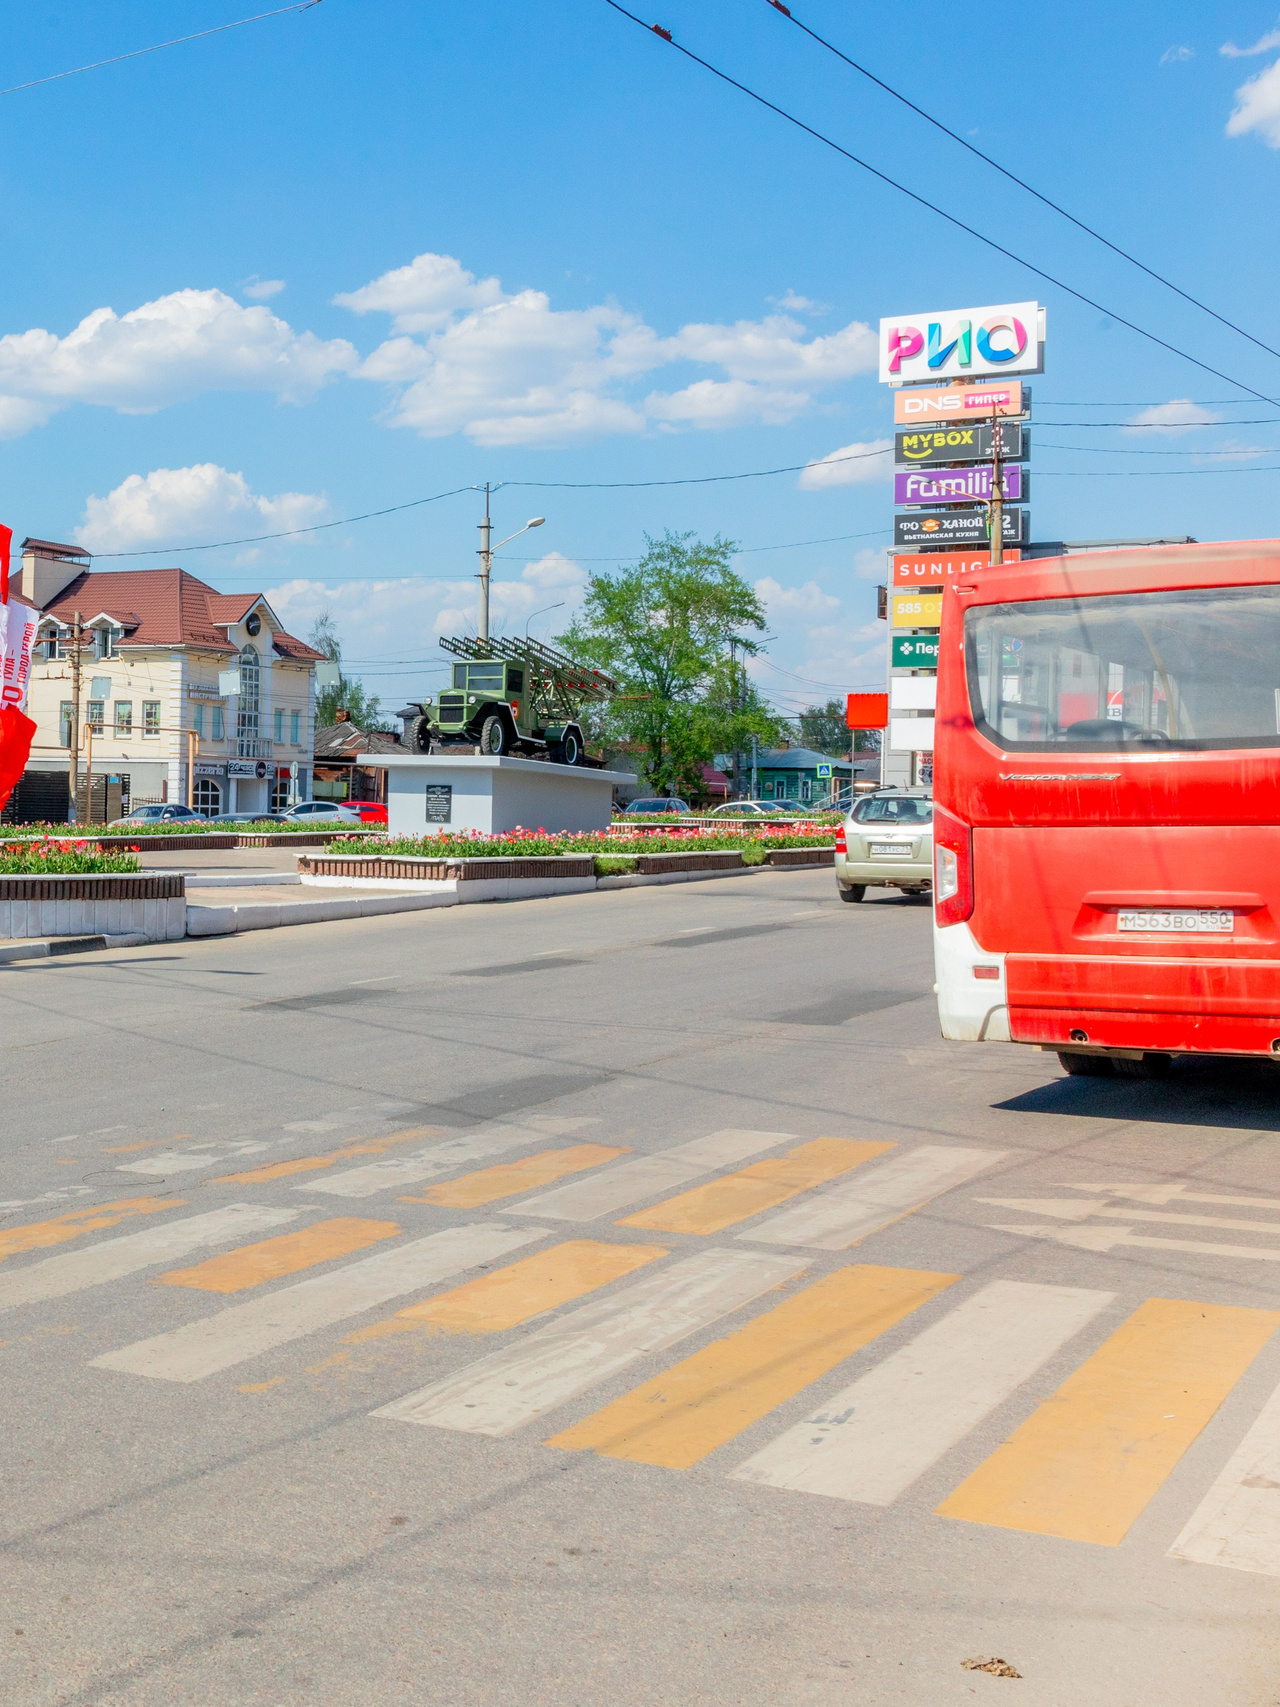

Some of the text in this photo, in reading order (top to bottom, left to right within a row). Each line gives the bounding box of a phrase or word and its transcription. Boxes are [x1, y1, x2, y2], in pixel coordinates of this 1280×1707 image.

[888, 315, 1027, 371] РИО
[904, 393, 1006, 413] DNS ГИПЕР
[903, 430, 973, 449] MYBOX
[985, 446, 1010, 455] ЭТЖ
[899, 517, 983, 531] ФО ХАНОЙ
[1002, 515, 1011, 528] 2
[904, 532, 953, 540] ВЬЕТНАМСКАЯ
[900, 560, 1015, 576] SUNLIG
[897, 603, 921, 614] 585
[17, 622, 36, 684] ГОРОД-ГЕРОЙ
[3, 658, 15, 680] ТУЛА
[999, 773, 1066, 781] VECTOR
[1200, 911, 1228, 924] 550
